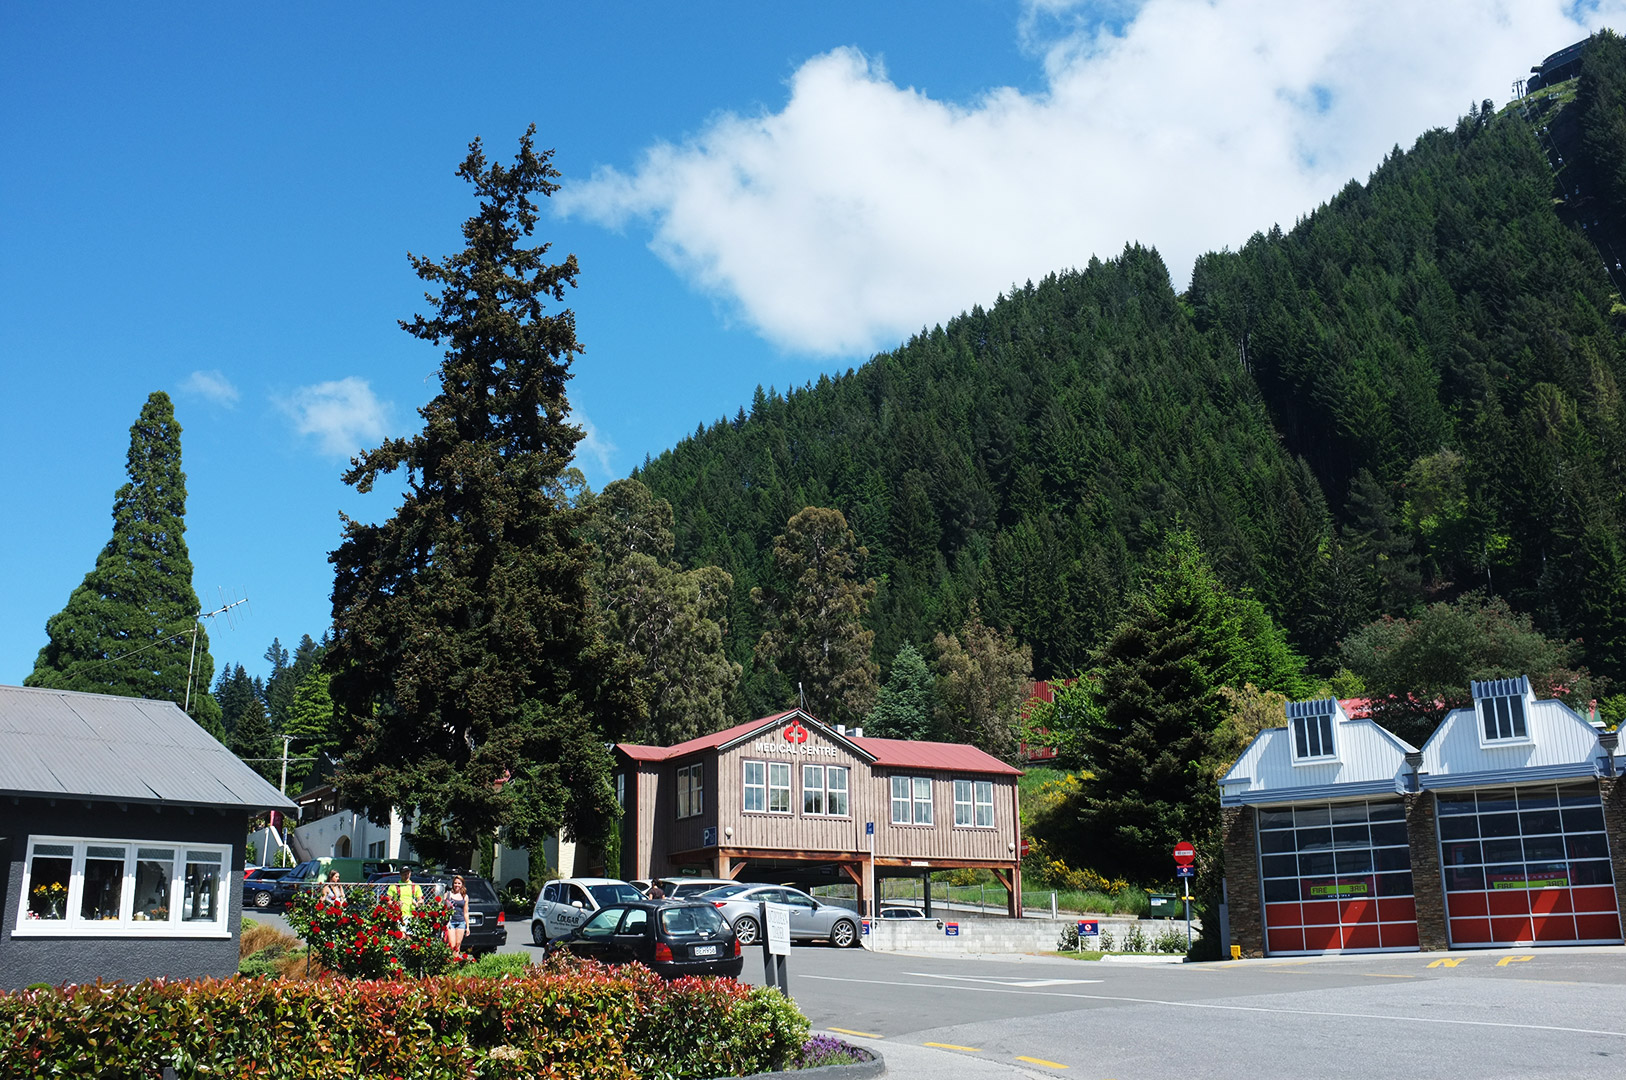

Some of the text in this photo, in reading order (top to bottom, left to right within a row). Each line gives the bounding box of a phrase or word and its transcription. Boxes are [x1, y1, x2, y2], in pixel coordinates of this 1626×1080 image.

[755, 743, 837, 756] MEDICAL CENTRE
[704, 829, 710, 846] P
[557, 913, 580, 924] COUGAR
[1426, 955, 1536, 969] N P
